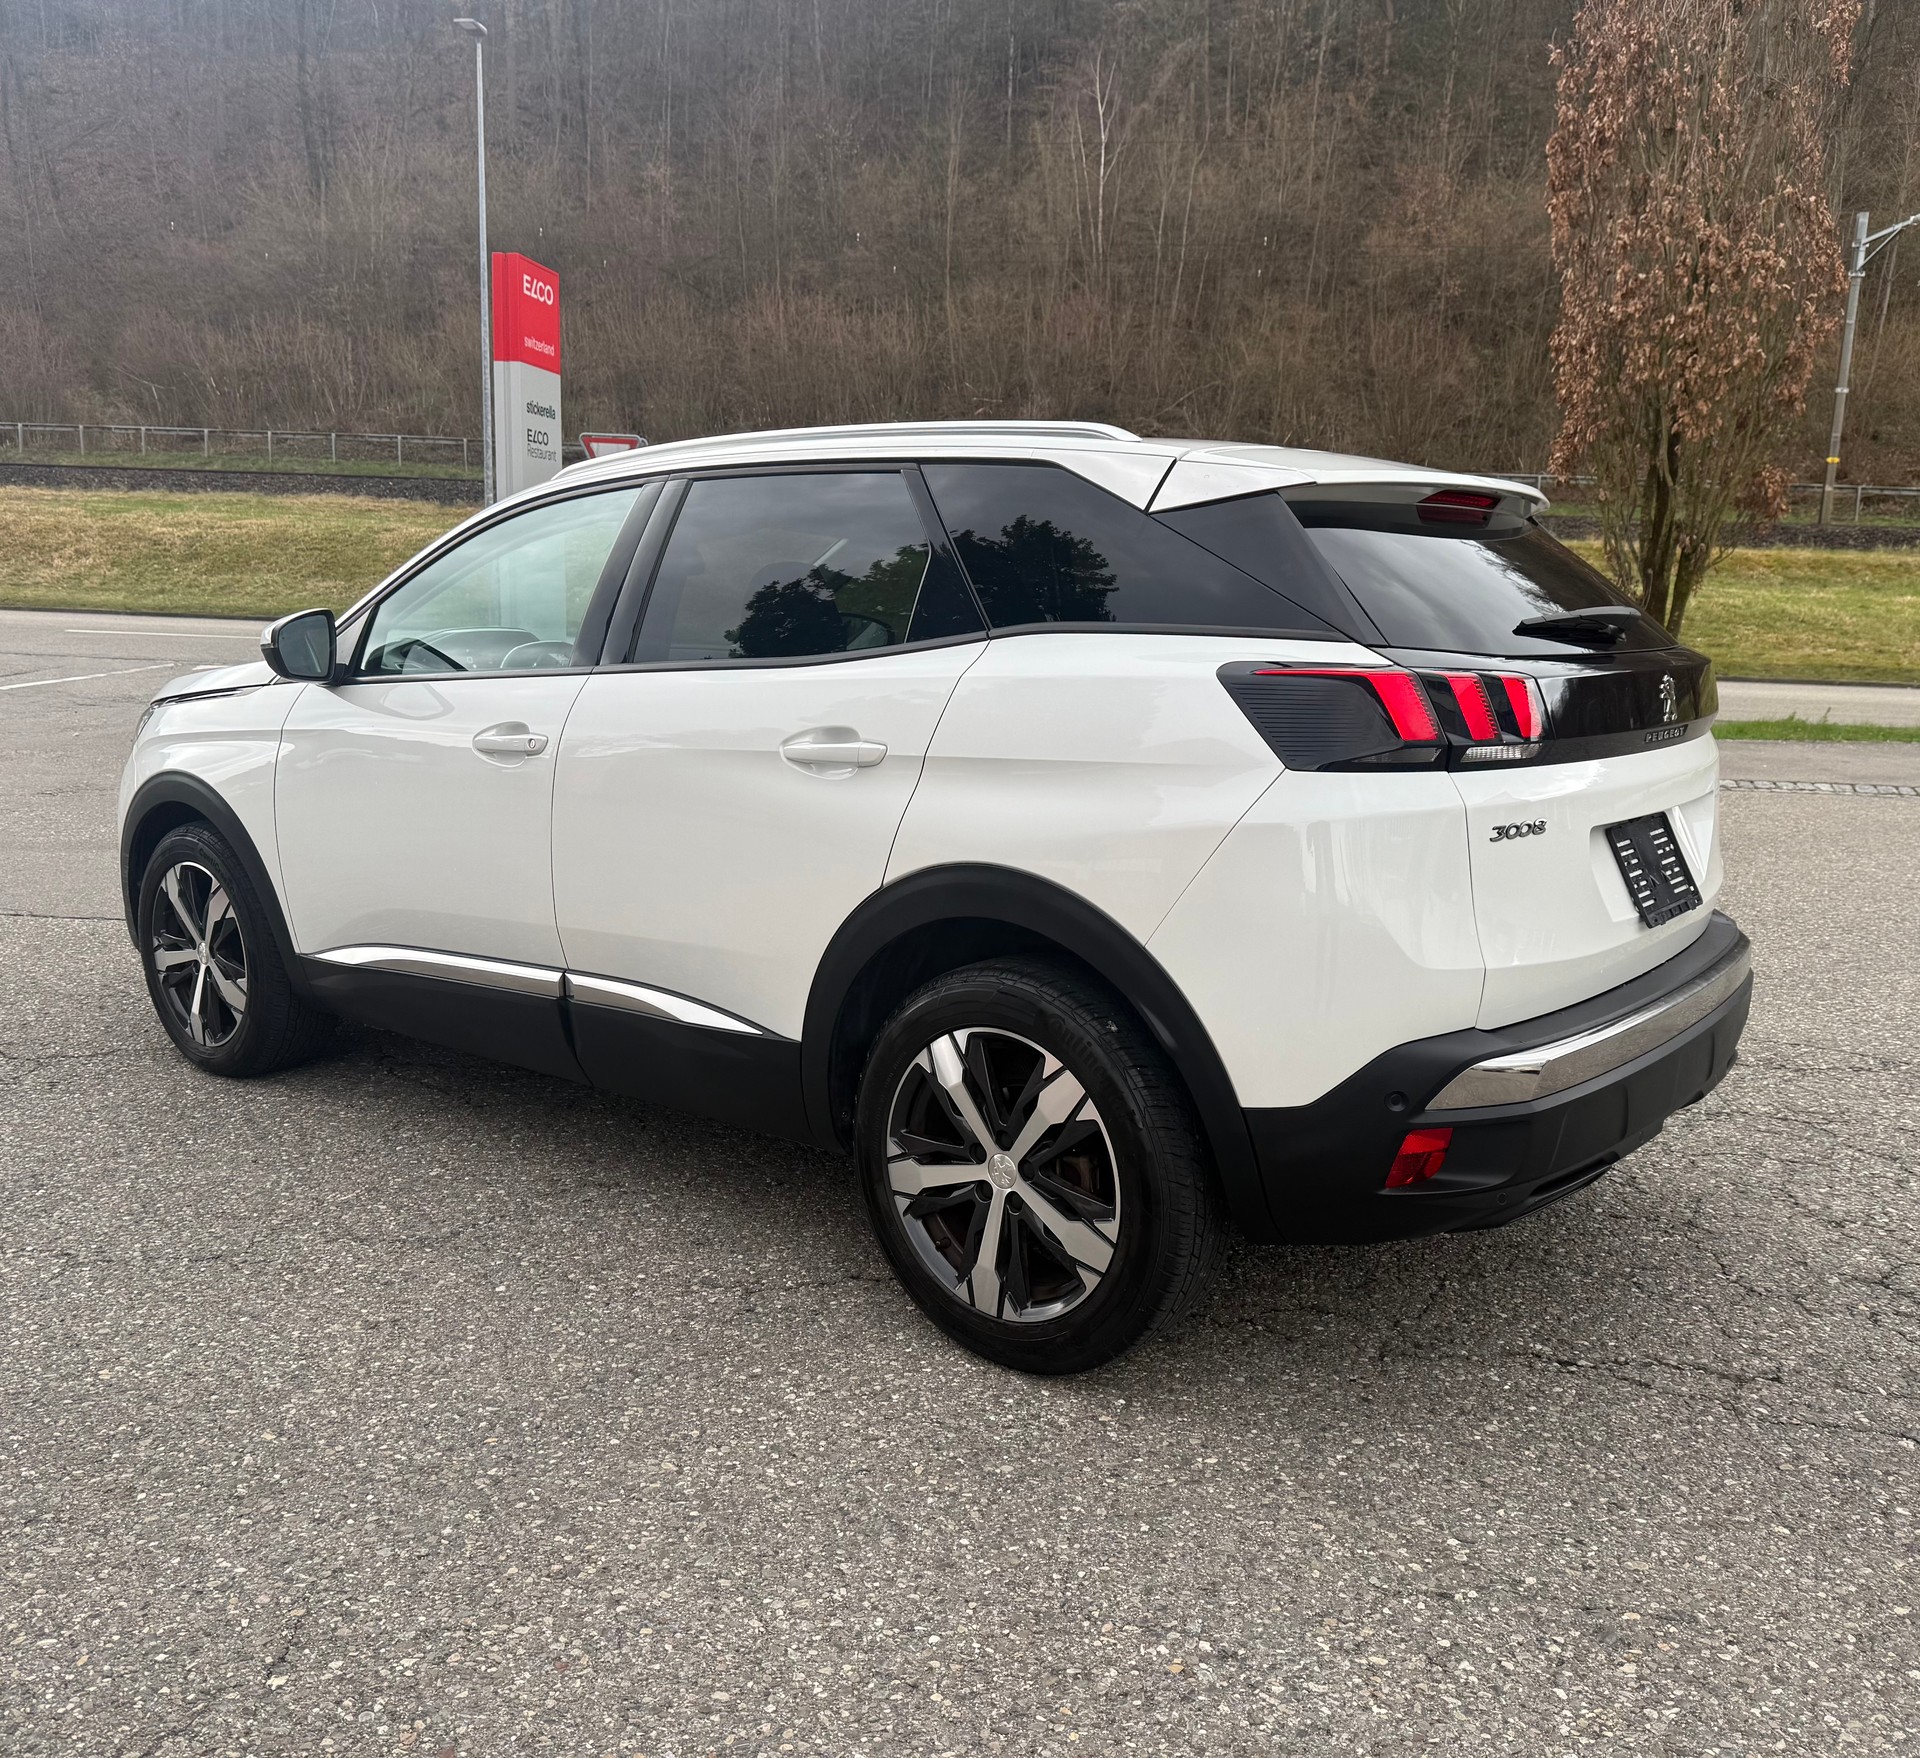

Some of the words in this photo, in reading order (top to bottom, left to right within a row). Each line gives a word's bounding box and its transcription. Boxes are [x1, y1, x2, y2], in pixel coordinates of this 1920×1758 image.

[523, 273, 554, 306] ELCO
[524, 336, 555, 356] switzerland
[526, 400, 555, 420] stickerella
[527, 428, 549, 446] ELCO
[527, 443, 557, 462] Restaurant
[1645, 726, 1685, 743] PEUGEOT
[1489, 818, 1548, 842] 3008
